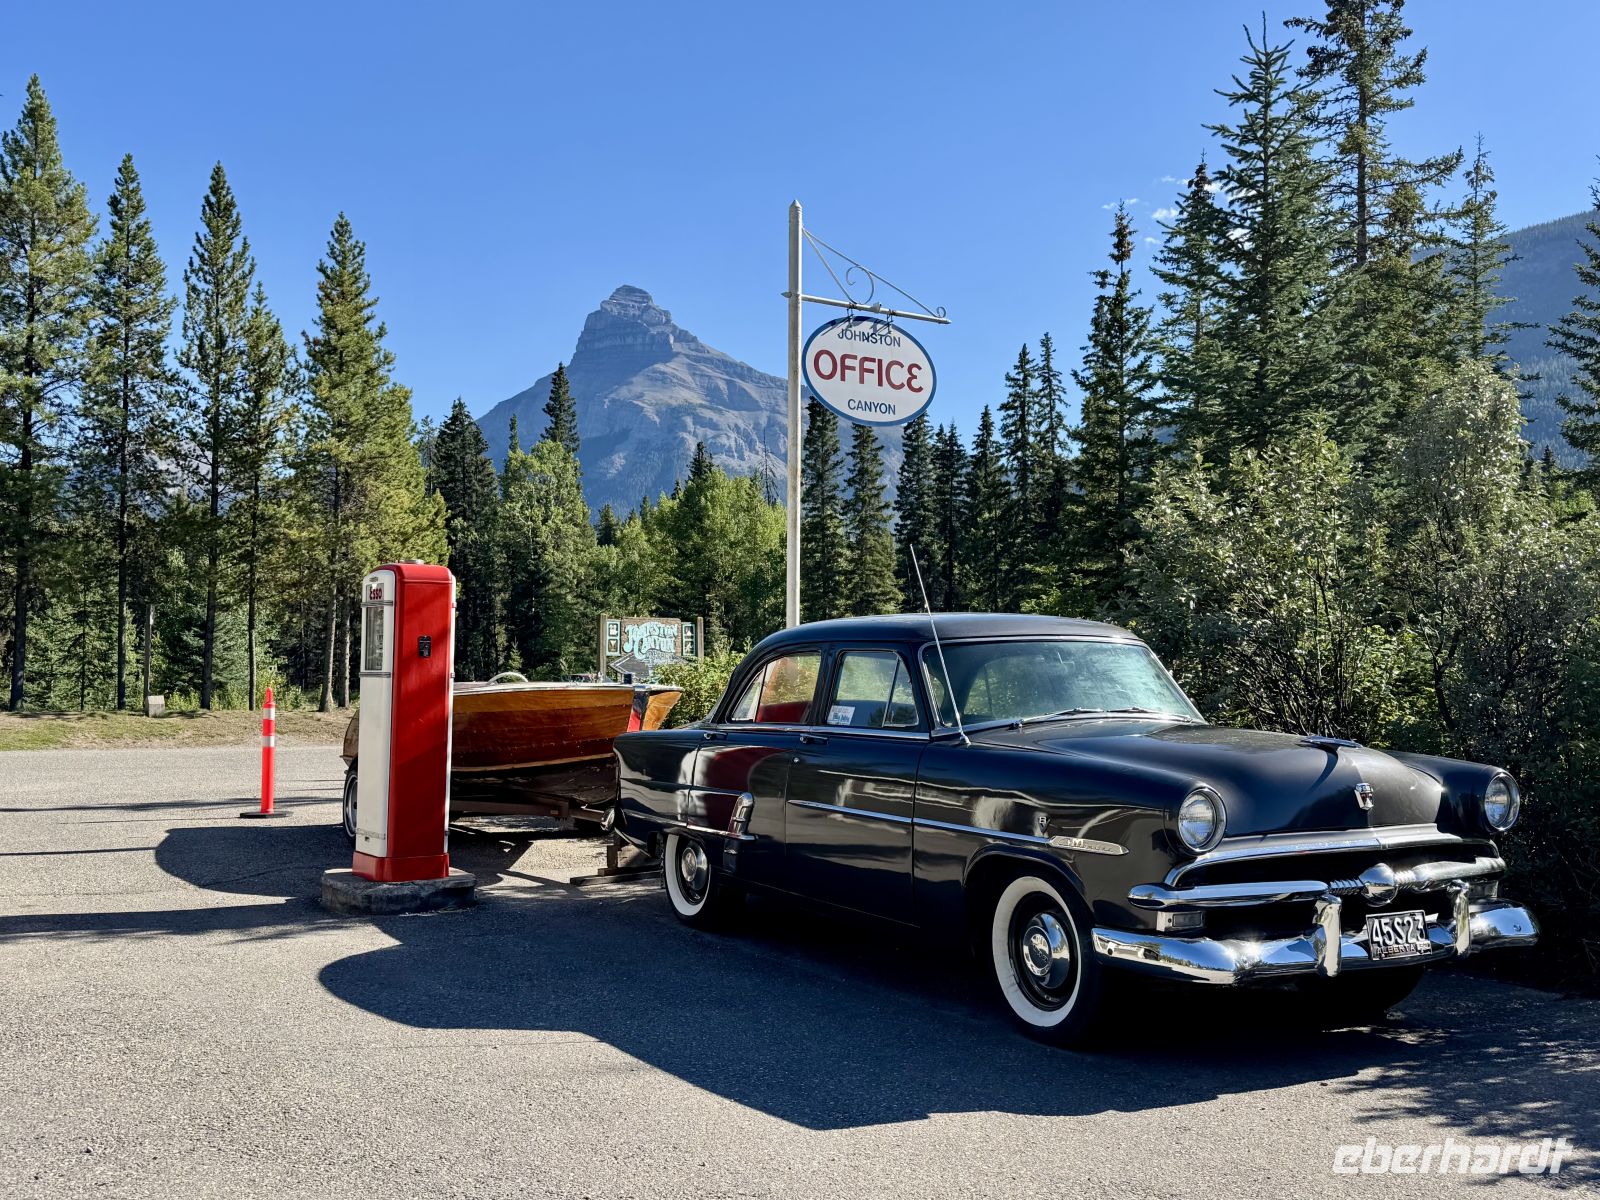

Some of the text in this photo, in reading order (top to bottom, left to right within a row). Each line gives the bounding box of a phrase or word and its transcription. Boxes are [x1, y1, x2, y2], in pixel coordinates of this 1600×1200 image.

[837, 328, 901, 348] JOHNSTON
[813, 349, 924, 393] OFFICE
[847, 398, 896, 415] CANYON
